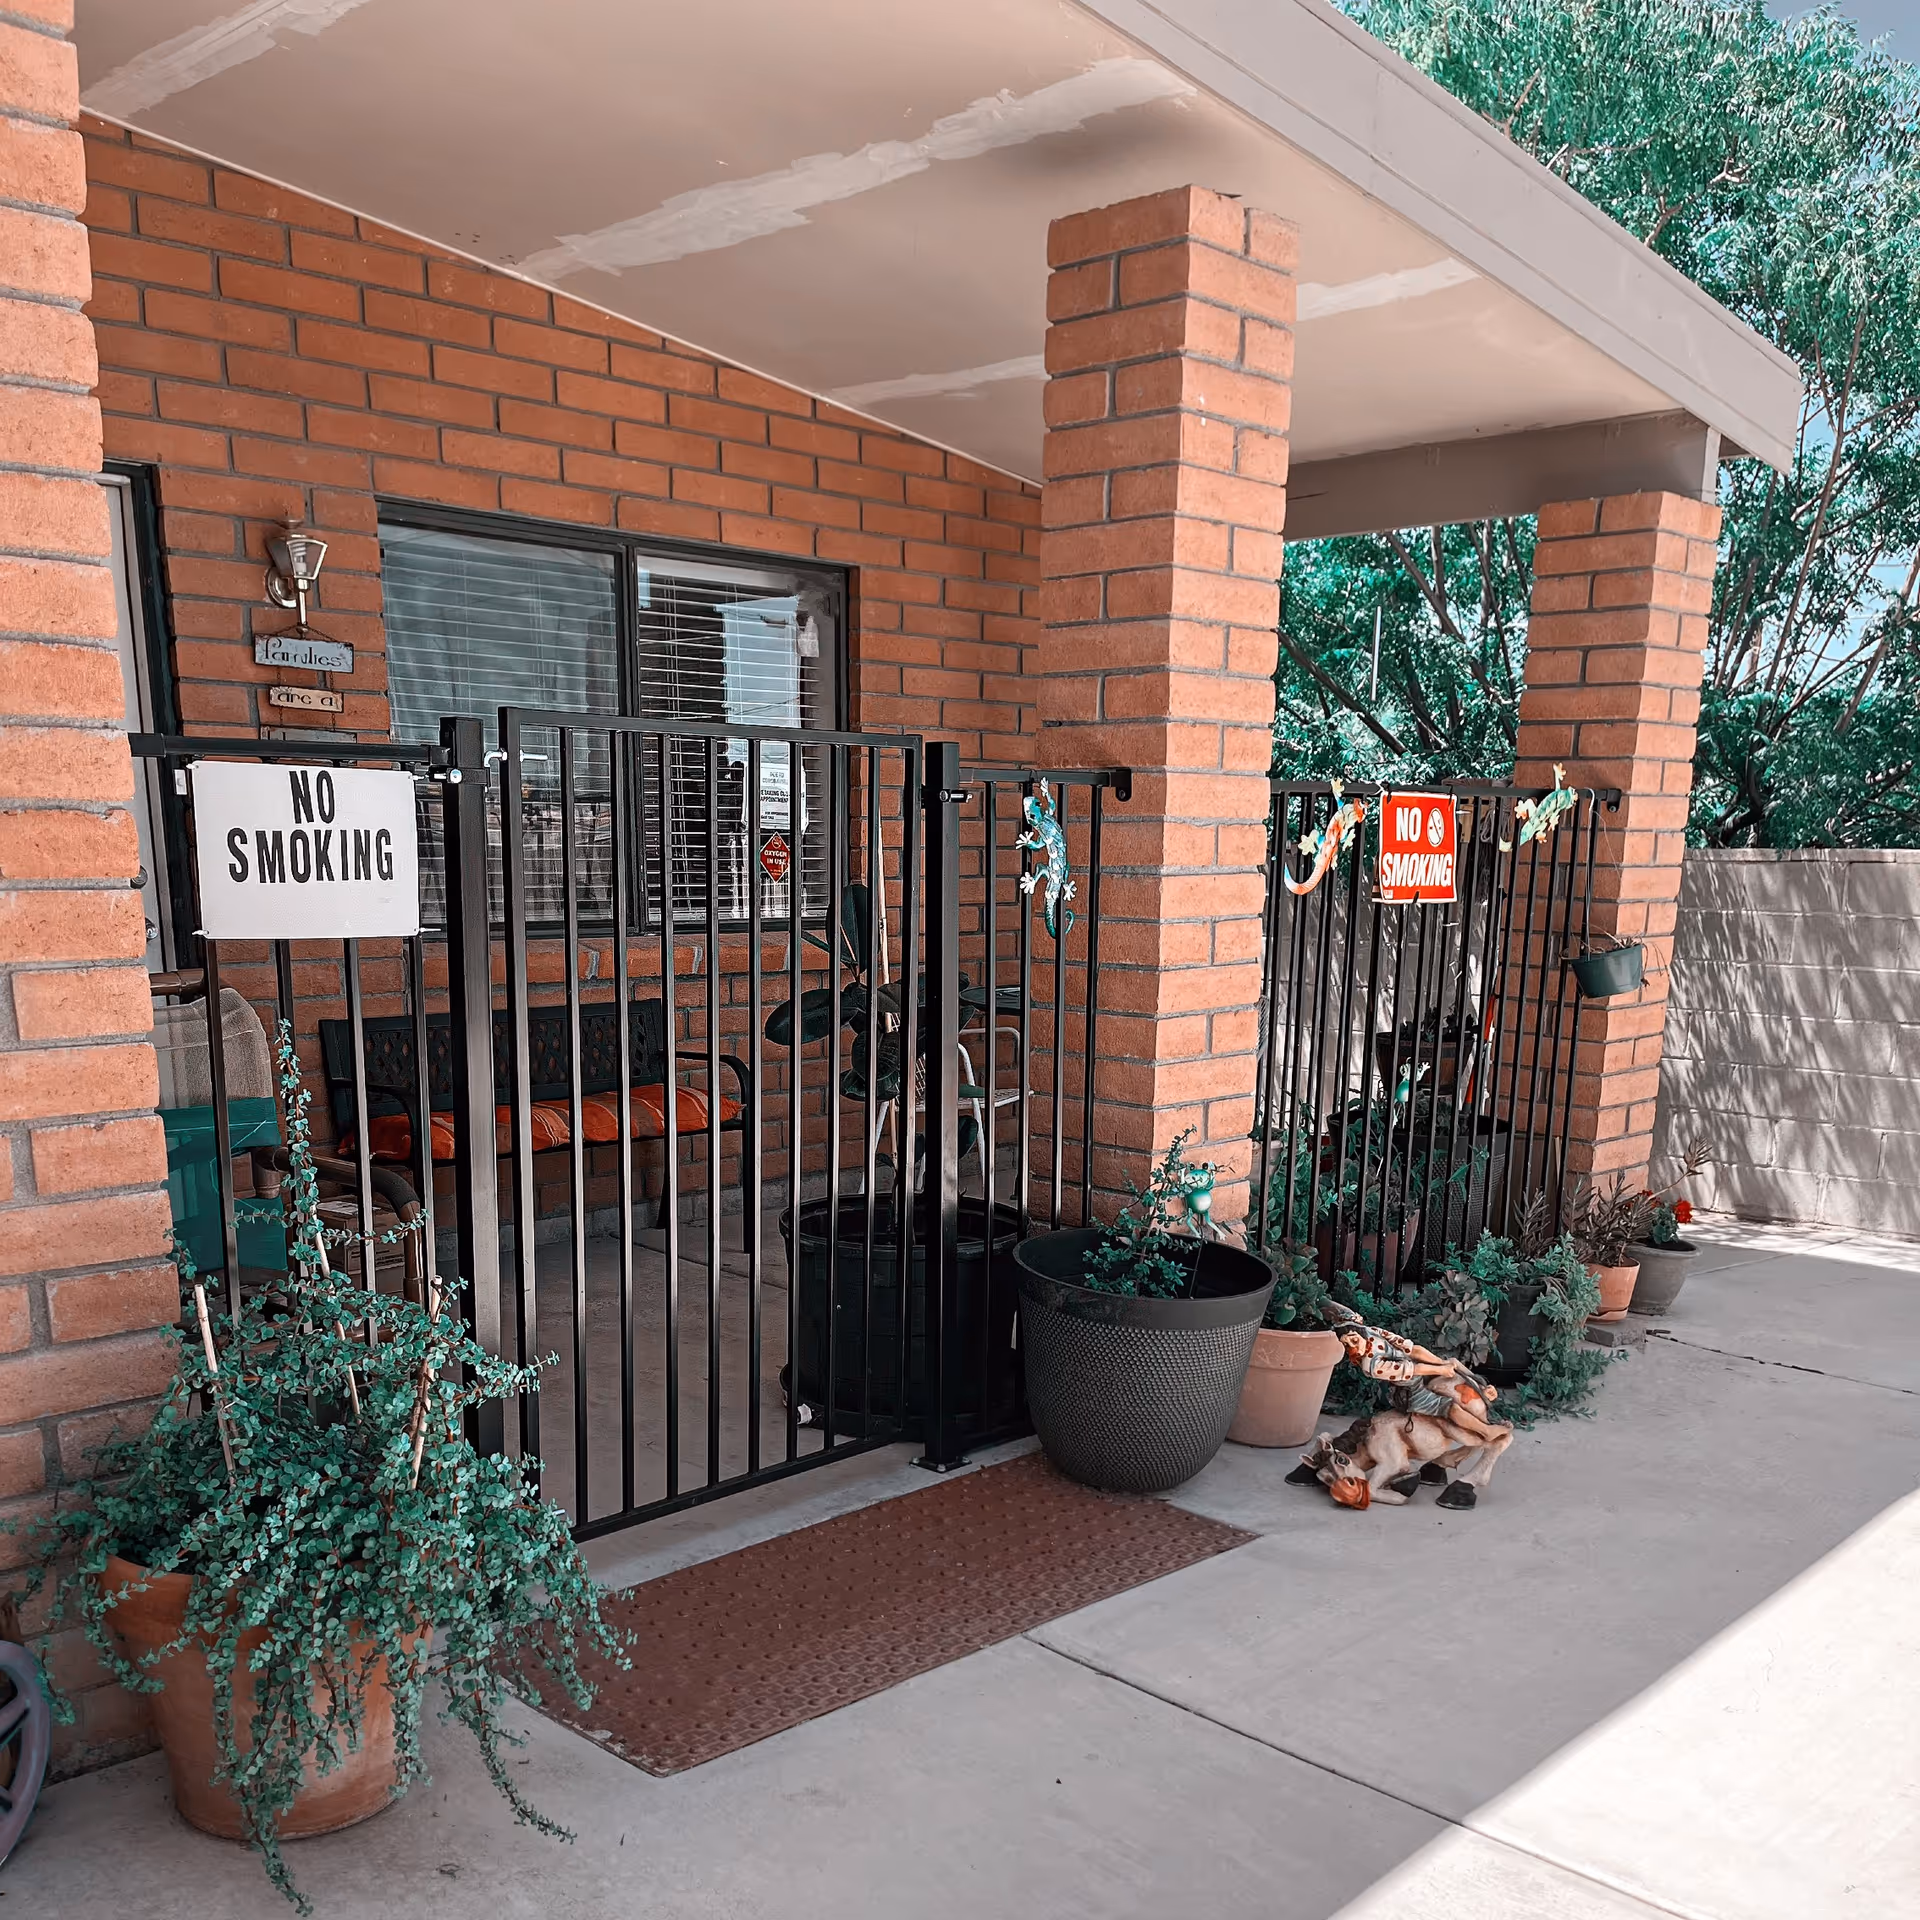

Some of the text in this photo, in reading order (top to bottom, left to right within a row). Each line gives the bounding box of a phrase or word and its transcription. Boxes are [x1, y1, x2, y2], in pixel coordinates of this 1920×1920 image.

[277, 692, 333, 707] are a
[288, 769, 335, 824] NO
[1396, 807, 1422, 842] NO
[226, 827, 393, 884] SMOKING
[764, 849, 787, 857] OXYGEN
[1382, 852, 1453, 887] SMOKING
